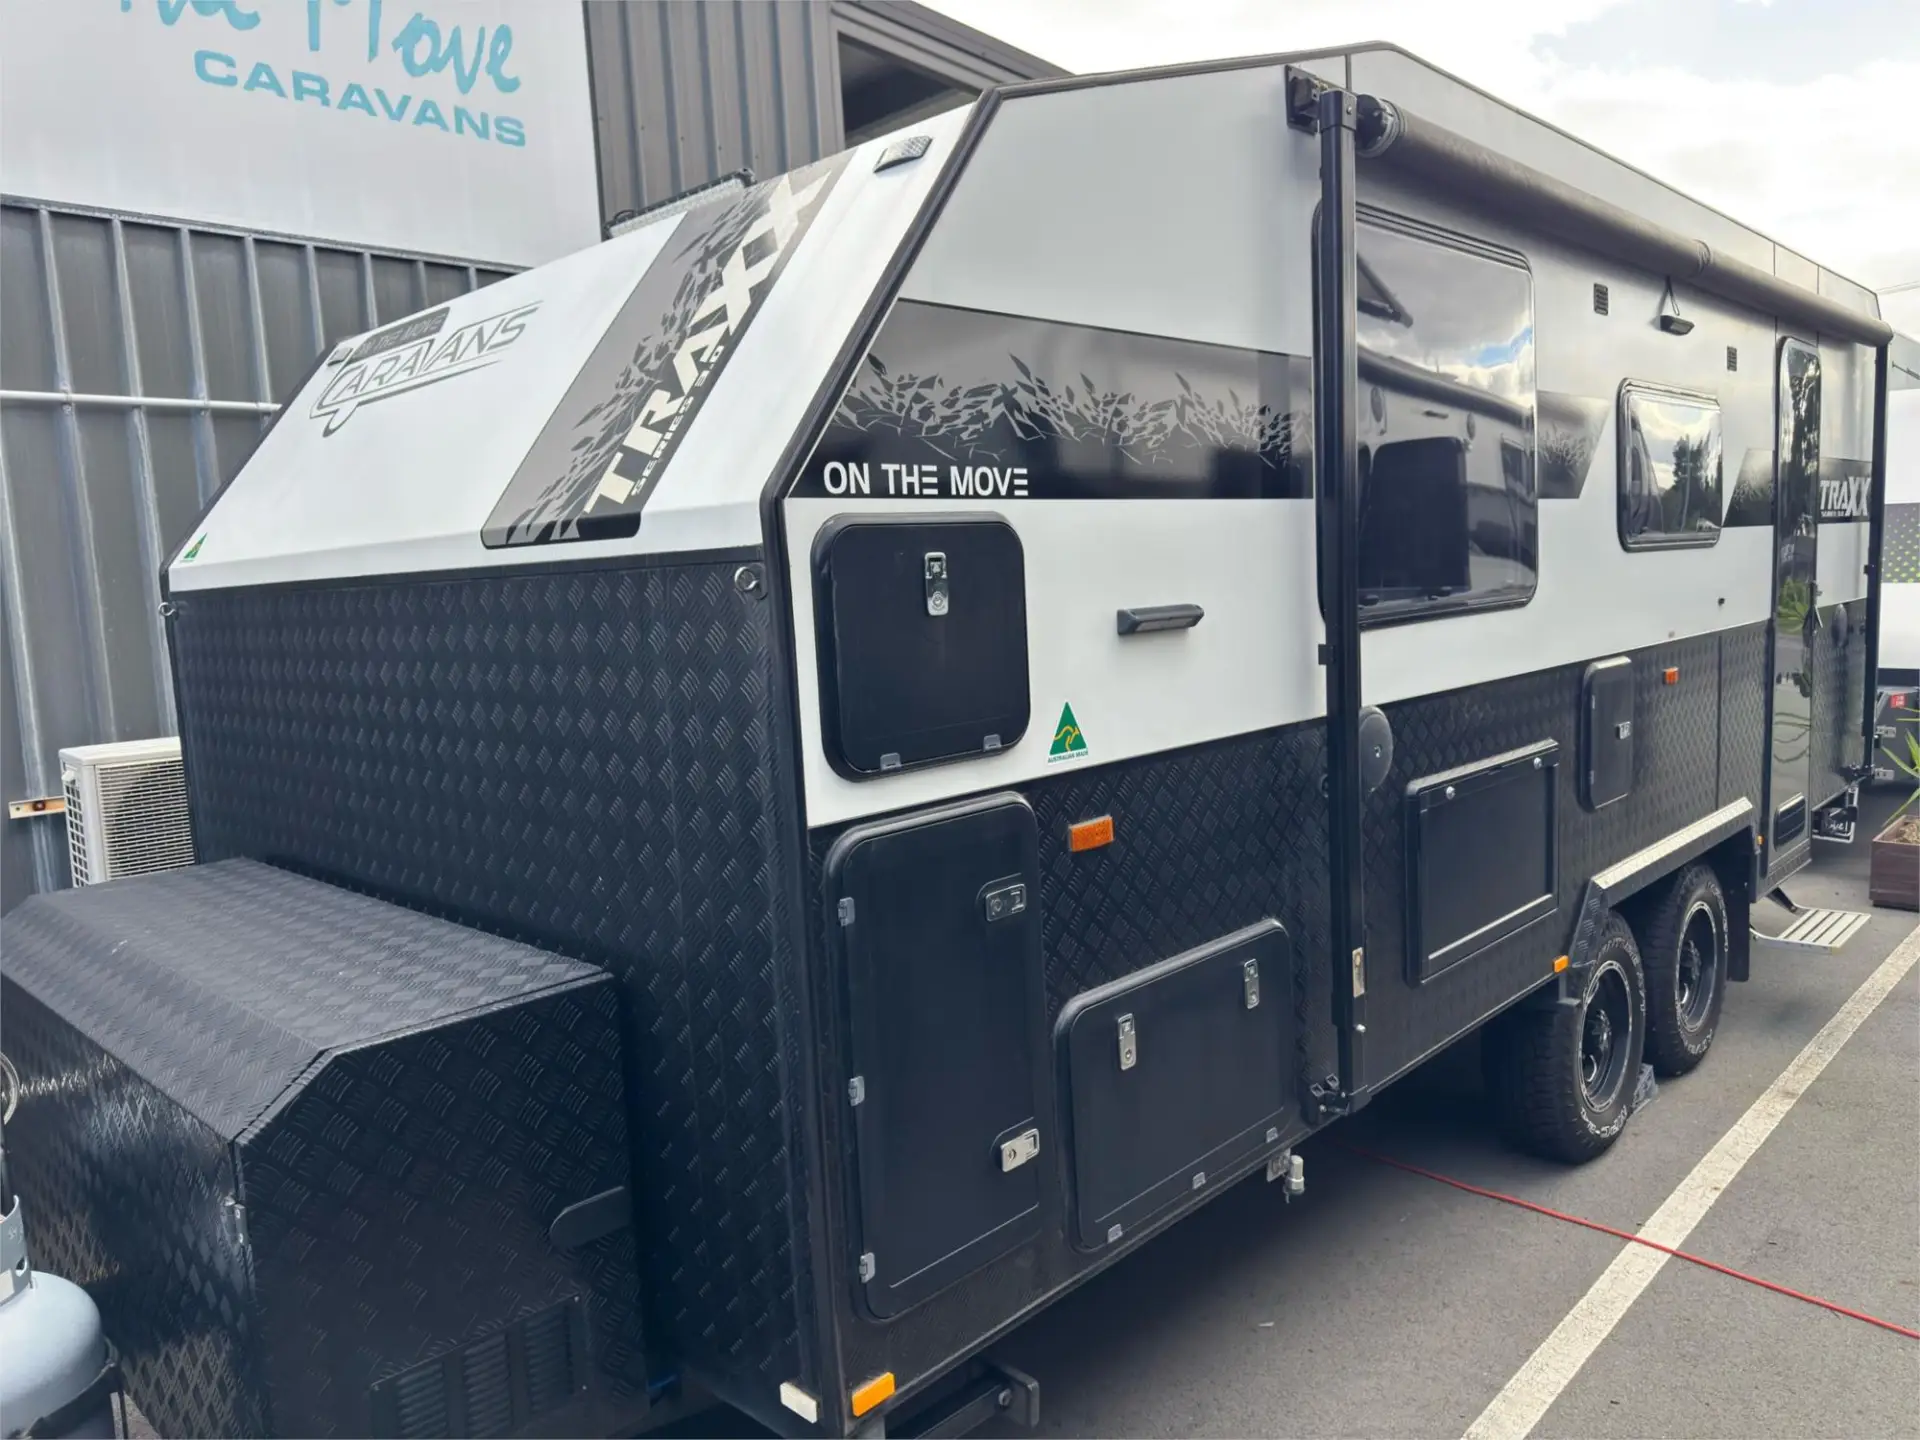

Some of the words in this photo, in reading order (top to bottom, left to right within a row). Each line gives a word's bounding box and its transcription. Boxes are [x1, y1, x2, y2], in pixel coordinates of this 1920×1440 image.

[194, 50, 526, 147] CARAVANS
[314, 304, 540, 411] CARAVANS
[583, 173, 831, 514] TRAXX
[630, 396, 694, 497] SERIES
[823, 461, 870, 495] ON
[881, 463, 939, 495] THE
[950, 465, 1029, 496] MOVE
[1820, 476, 1870, 517] TRAXX
